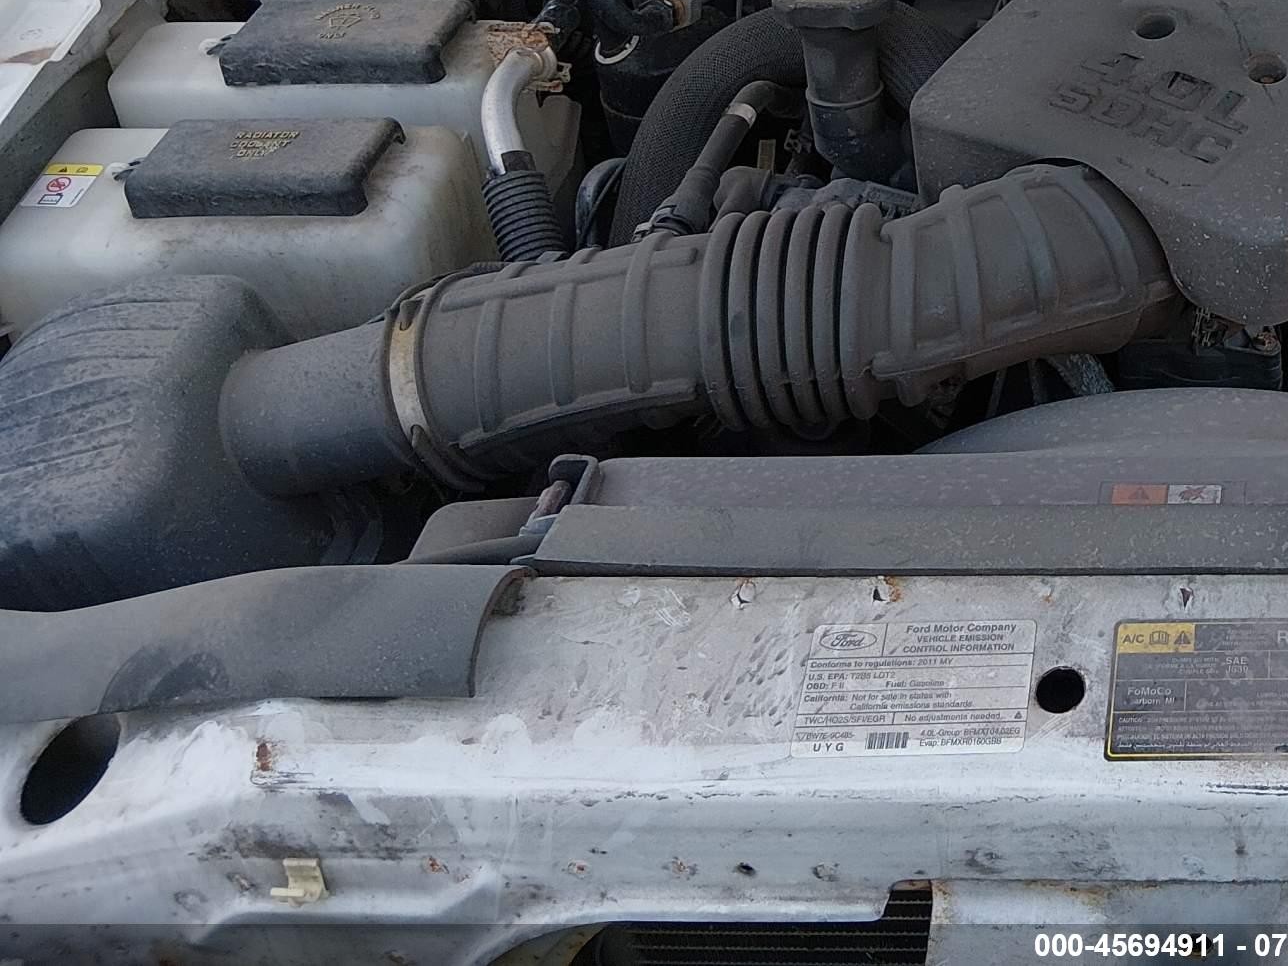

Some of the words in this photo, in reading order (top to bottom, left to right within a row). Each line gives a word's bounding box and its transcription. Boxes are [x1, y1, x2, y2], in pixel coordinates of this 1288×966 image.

[235, 130, 299, 140] RADIATOR
[906, 625, 931, 634] Ford
[933, 624, 964, 633] Motor
[967, 623, 1017, 633] Company
[830, 633, 865, 648] Ford
[917, 635, 956, 643] VEHICLE
[958, 633, 1004, 642] EMISSION
[1122, 633, 1145, 644] A/C
[903, 645, 948, 653] CONTROL
[950, 643, 1015, 652] INFORMATION
[810, 661, 852, 669] Conforms
[940, 657, 953, 665] MY
[1226, 656, 1248, 665] SAE
[808, 673, 824, 681] U.S.
[1127, 687, 1172, 695] FoMoCo
[804, 694, 848, 703] California:
[868, 693, 879, 701] for
[850, 702, 888, 711] California
[890, 701, 930, 710] emissions
[904, 714, 916, 722] No
[918, 713, 968, 723] adjustments
